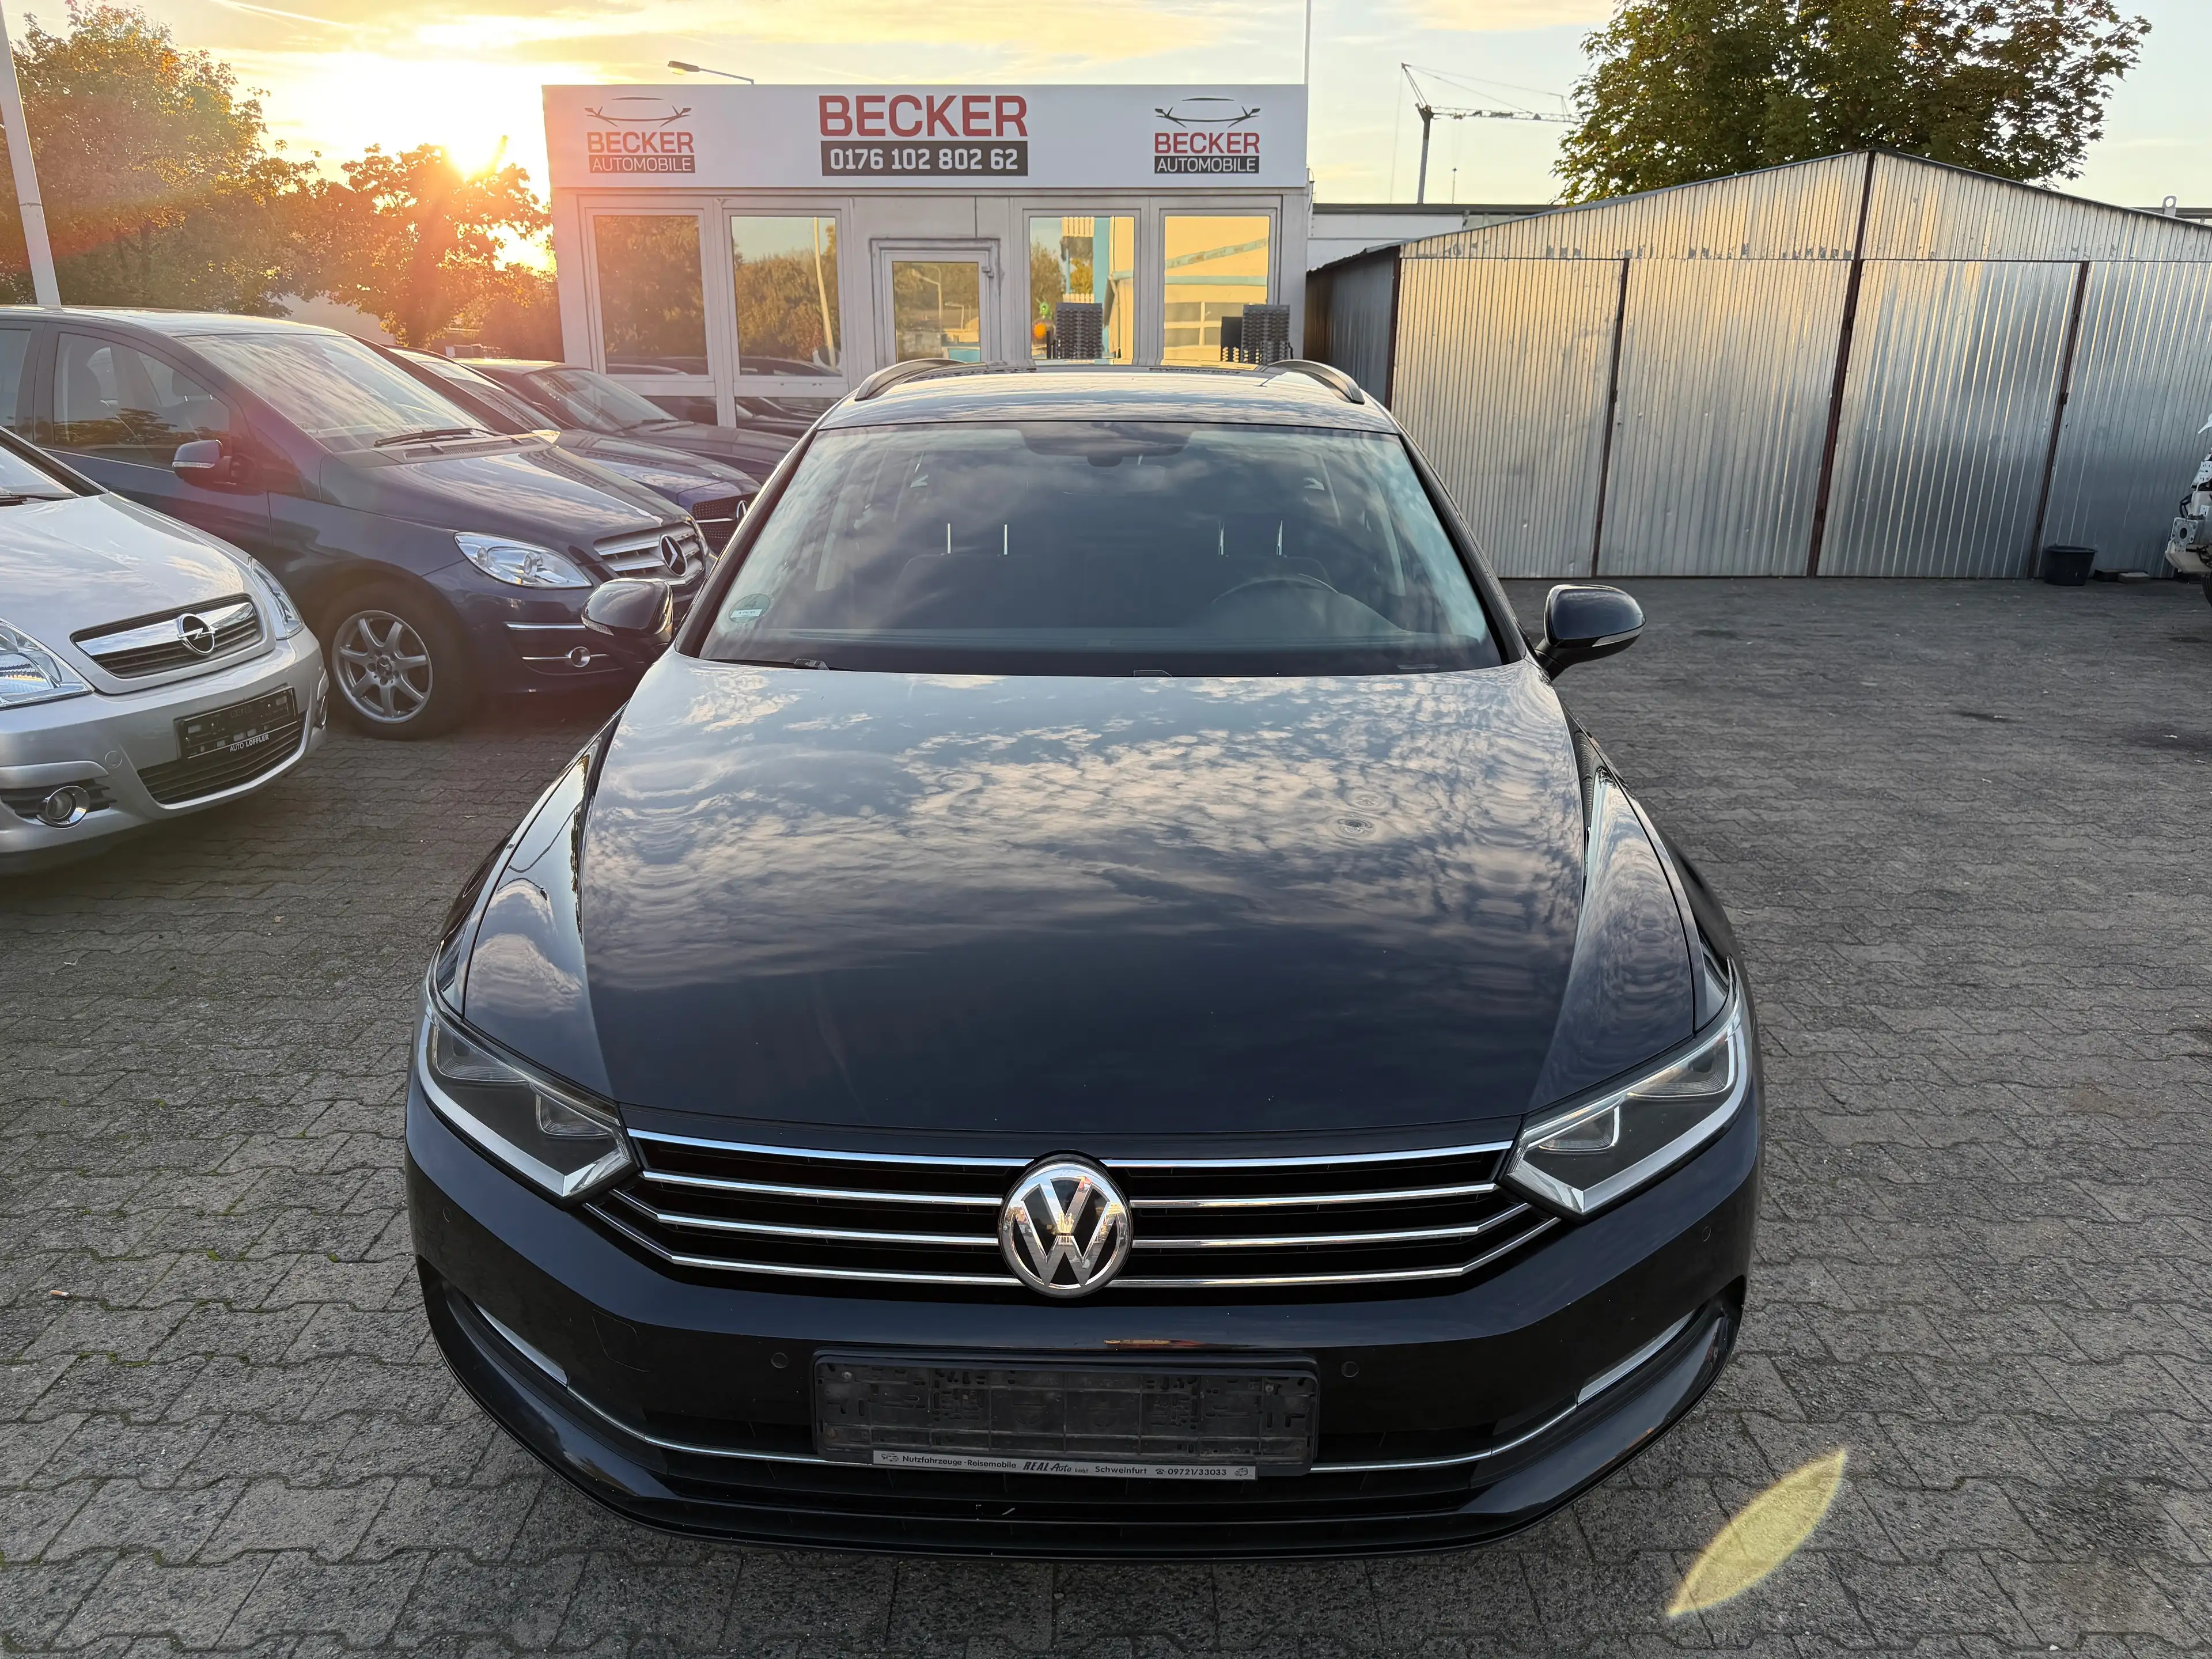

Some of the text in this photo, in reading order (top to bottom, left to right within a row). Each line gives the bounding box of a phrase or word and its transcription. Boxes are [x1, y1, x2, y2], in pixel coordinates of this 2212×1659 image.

[819, 95, 1028, 137] BECKER
[586, 132, 694, 153] BECKER
[1155, 132, 1260, 153] BECKER
[592, 157, 691, 172] AUTOMOBILE
[830, 148, 1018, 170] 0176 102 802 62
[1156, 158, 1256, 173] AUTOMOBILE
[230, 742, 244, 752] AUTO
[903, 1455, 962, 1466] Nutzfahrzeuge
[1022, 1461, 1050, 1472] REAL
[1094, 1465, 1147, 1475] Schweinfurt
[1168, 1468, 1227, 1476] 09721/33033
